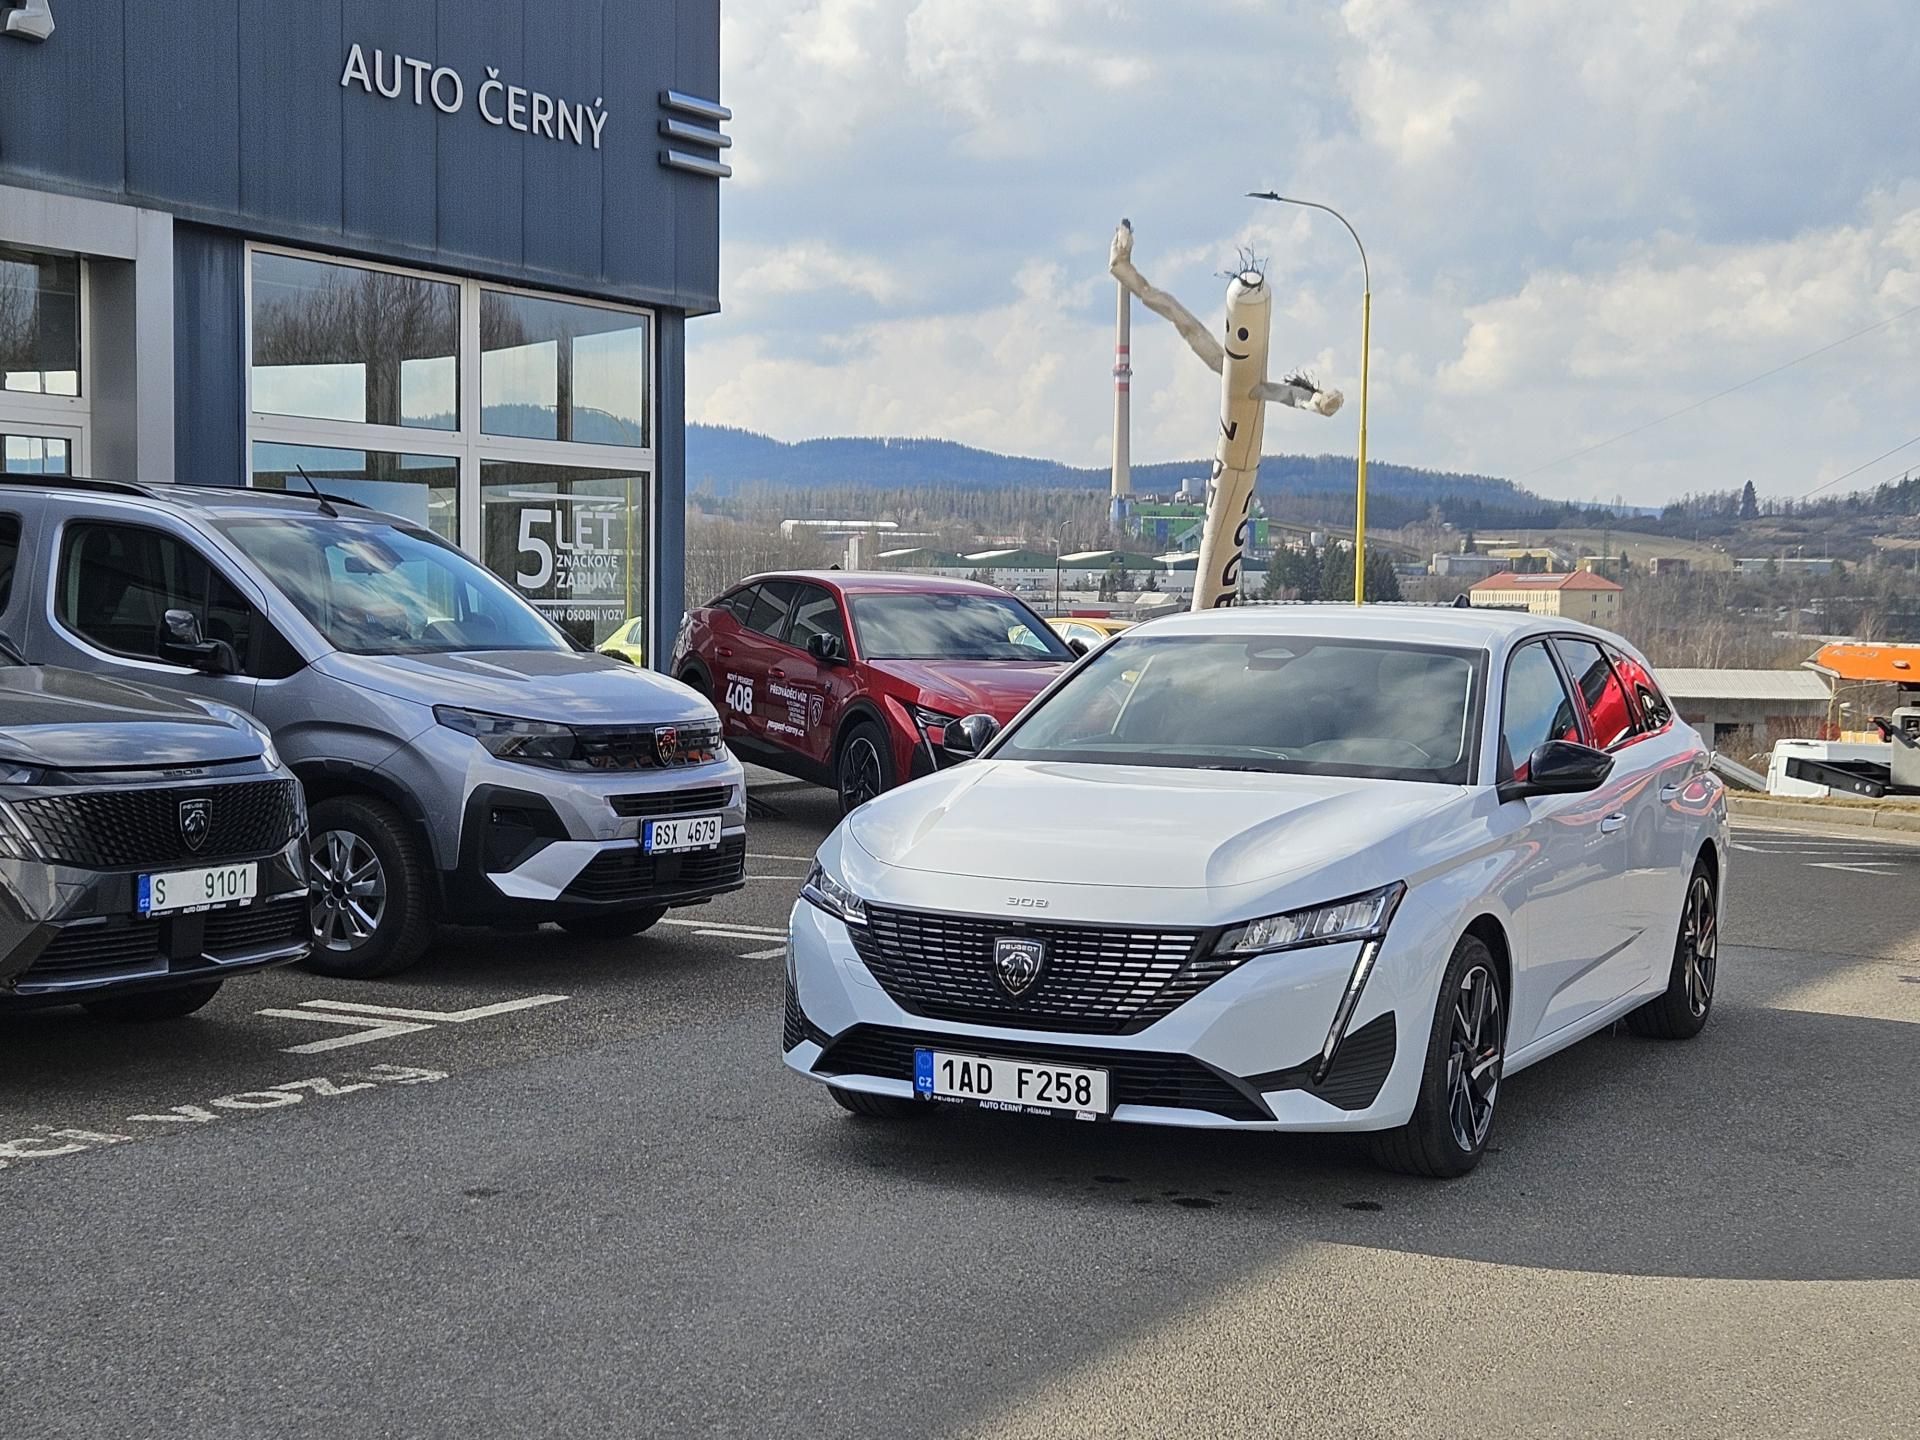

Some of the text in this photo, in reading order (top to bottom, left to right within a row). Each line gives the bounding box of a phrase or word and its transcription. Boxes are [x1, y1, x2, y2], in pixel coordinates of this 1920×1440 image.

[341, 43, 608, 149] AUTO ČERNÝ
[517, 508, 617, 589] 5 LET
[556, 566, 617, 589] ZÁRUKY
[566, 606, 601, 621] OSOBNÍ
[602, 609, 625, 621] VOZY
[725, 682, 754, 715] 408
[655, 820, 716, 846] 6SX 4679
[155, 868, 248, 905] S 9101
[139, 898, 150, 908] CZ
[1006, 896, 1049, 908] 308
[1000, 943, 1038, 953] PEUGEOT
[918, 1075, 932, 1088] CZ
[942, 1059, 1091, 1106] 1AD F258
[933, 1094, 964, 1104] PEUGEOT
[979, 1100, 999, 1110] AUTO
[1000, 1101, 1023, 1113] ČERNÝ
